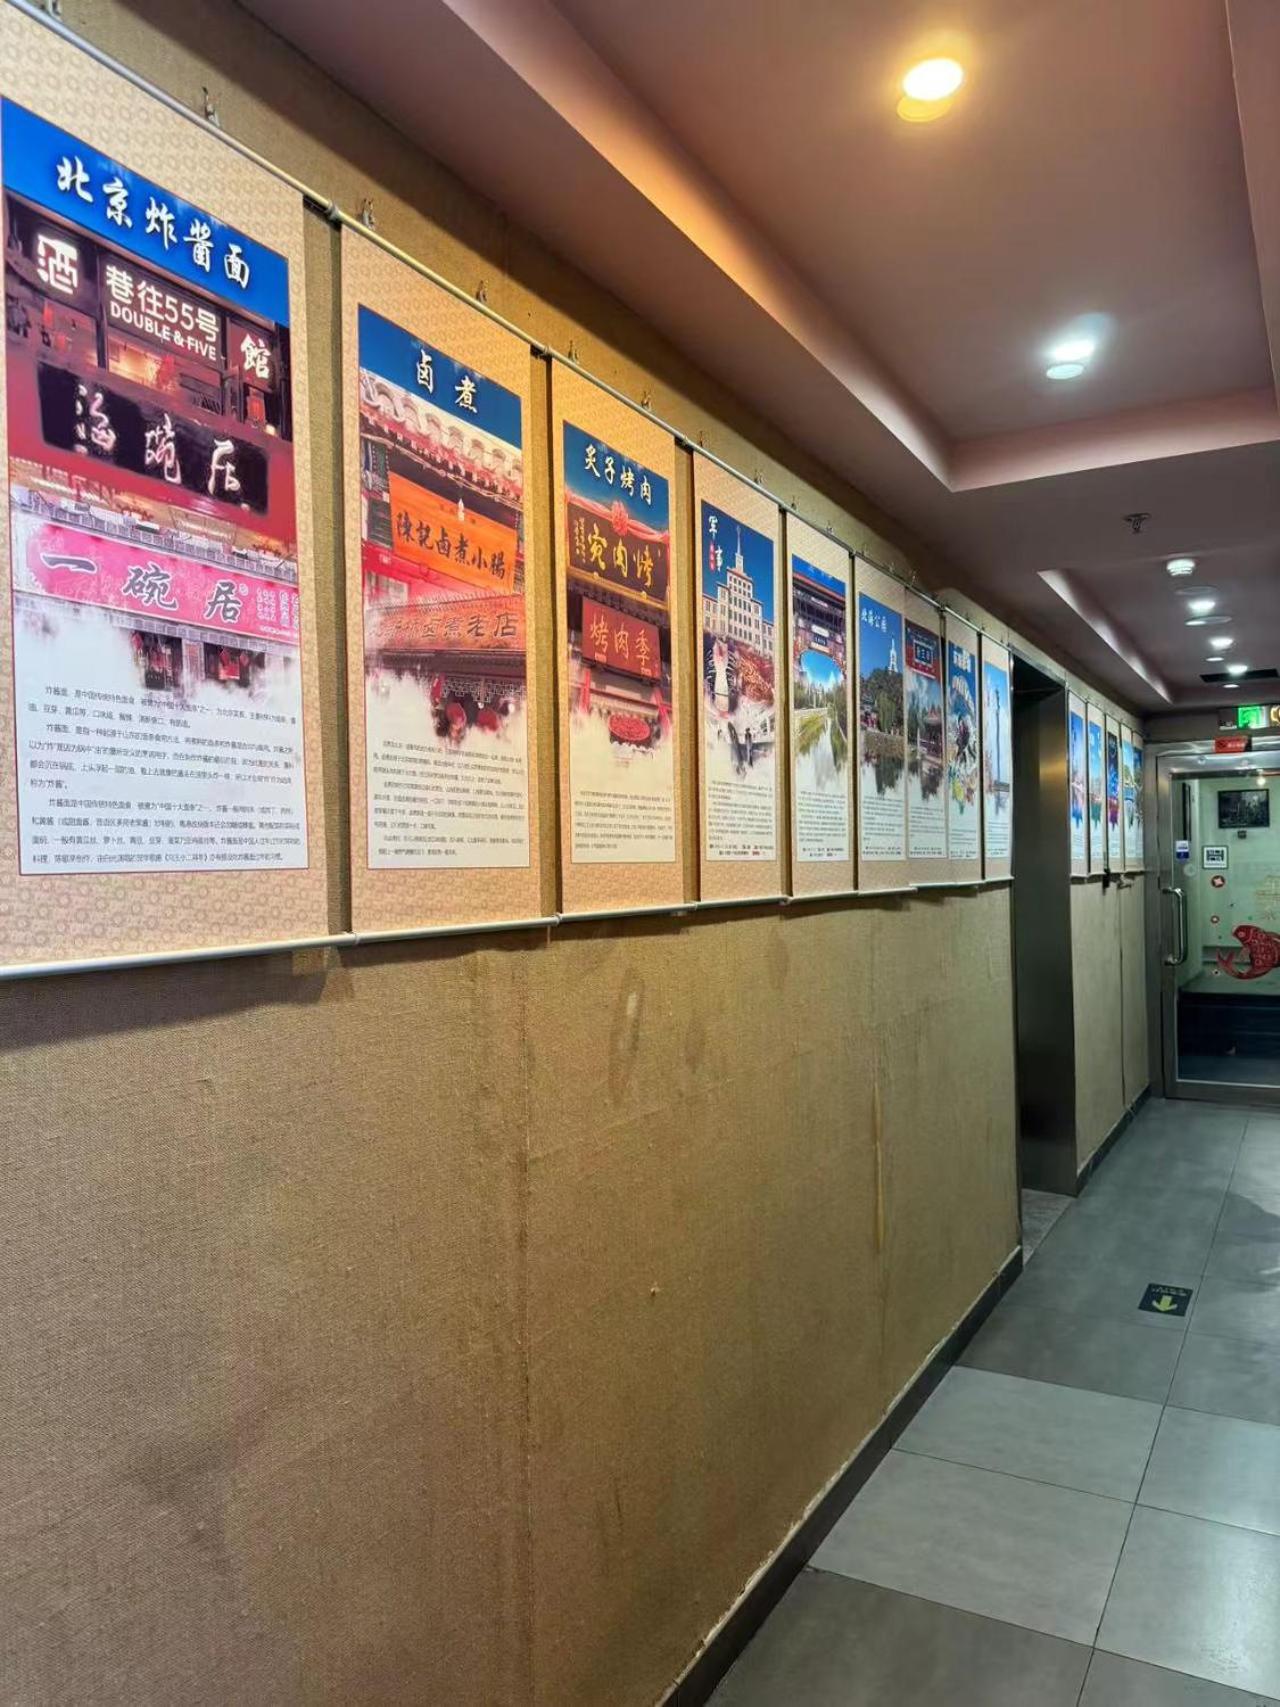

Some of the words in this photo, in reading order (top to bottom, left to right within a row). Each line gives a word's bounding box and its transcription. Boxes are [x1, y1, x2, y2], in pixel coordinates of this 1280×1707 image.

[56, 155, 250, 289] 北京炸酱面
[36, 233, 79, 295] 酒
[106, 265, 220, 342] 巷往55号
[187, 337, 217, 362] FIVE
[416, 348, 478, 413] 卤煮
[584, 443, 652, 505] 炙子烤肉
[40, 553, 245, 624] 一碗居
[590, 612, 651, 667] 烤肉季
